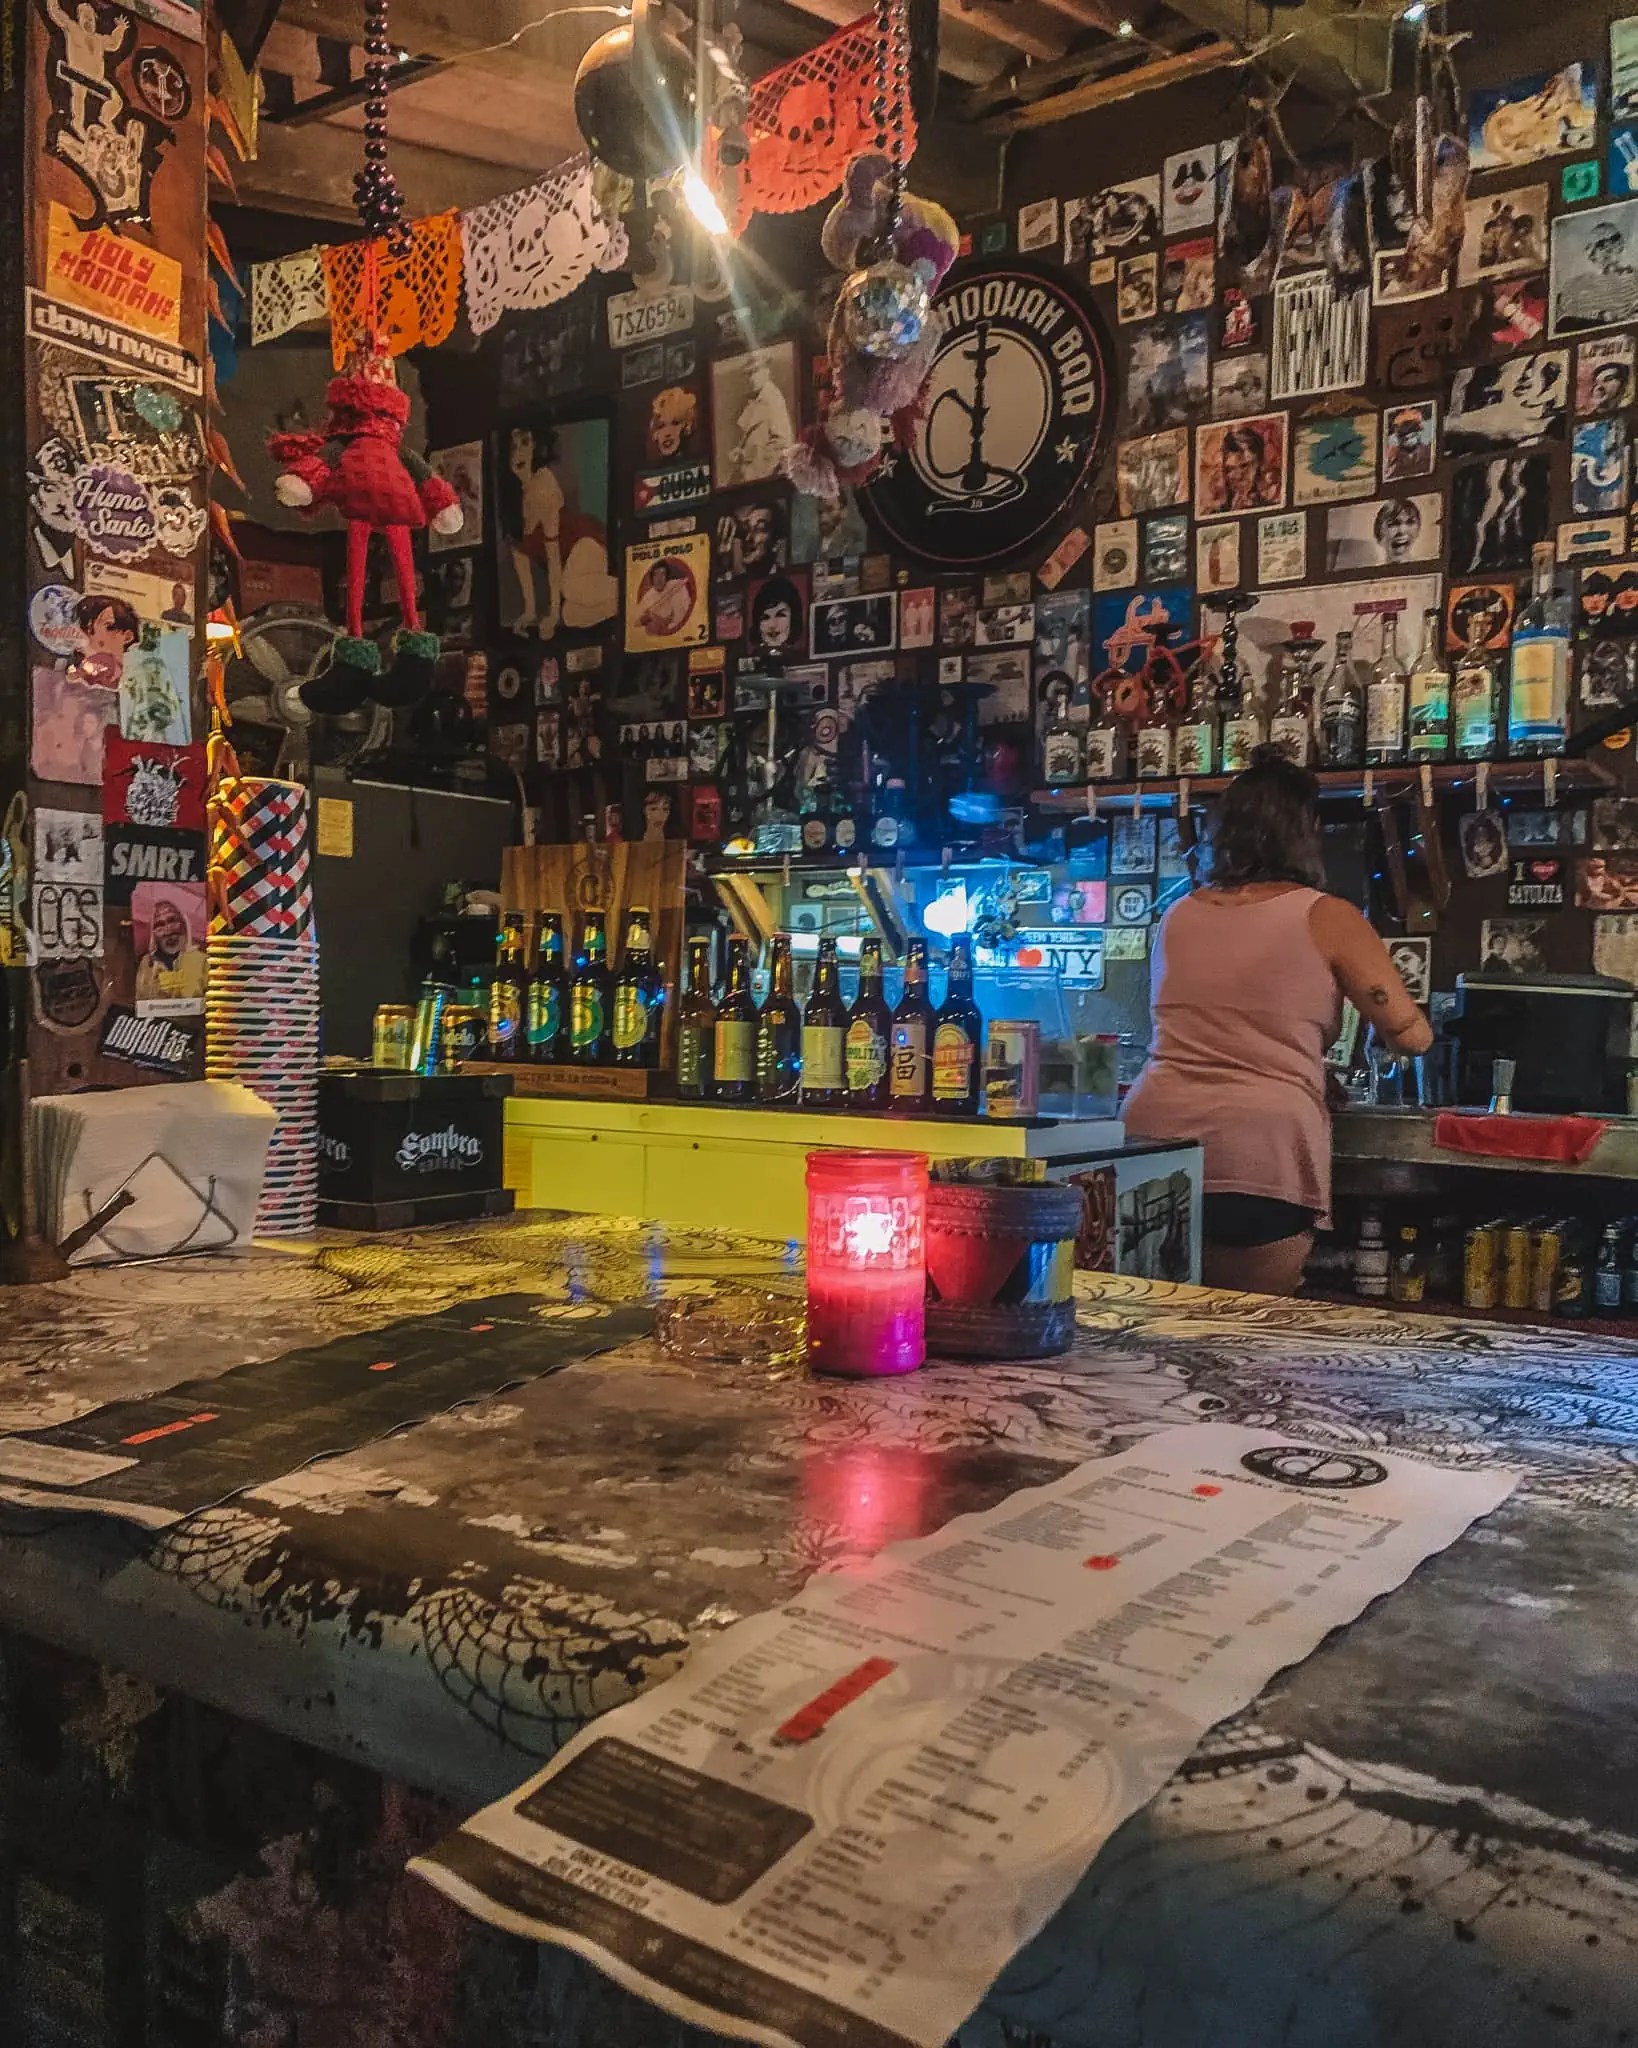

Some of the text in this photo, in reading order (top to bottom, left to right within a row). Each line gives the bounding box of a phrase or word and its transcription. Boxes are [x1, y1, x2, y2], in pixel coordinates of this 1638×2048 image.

[76, 477, 147, 511] Humo
[89, 507, 154, 539] Santo
[110, 842, 200, 882] SMRT.
[400, 1124, 481, 1163] Sombra
